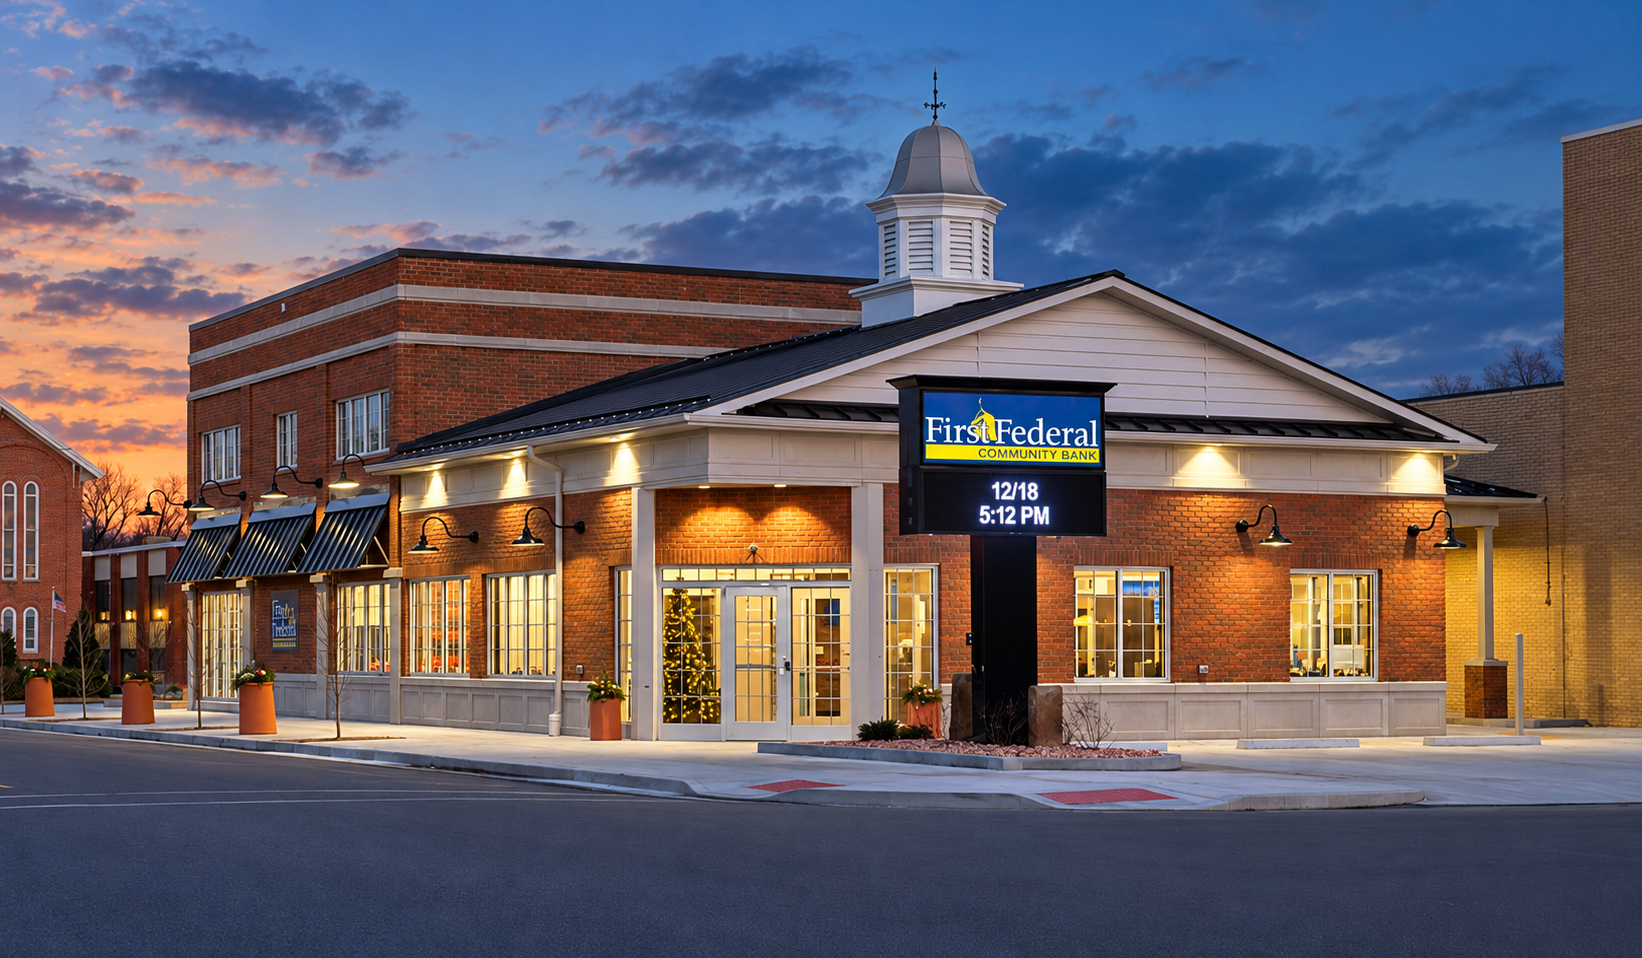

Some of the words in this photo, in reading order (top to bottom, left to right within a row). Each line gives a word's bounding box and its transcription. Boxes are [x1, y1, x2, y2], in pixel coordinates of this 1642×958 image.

[926, 416, 990, 444] First
[995, 417, 1099, 447] Federal
[978, 448, 1057, 460] COMMUNITY
[1062, 450, 1097, 461] BANK
[991, 481, 1039, 501] 12/18
[979, 505, 1017, 525] 5:12
[1020, 506, 1050, 526] PM
